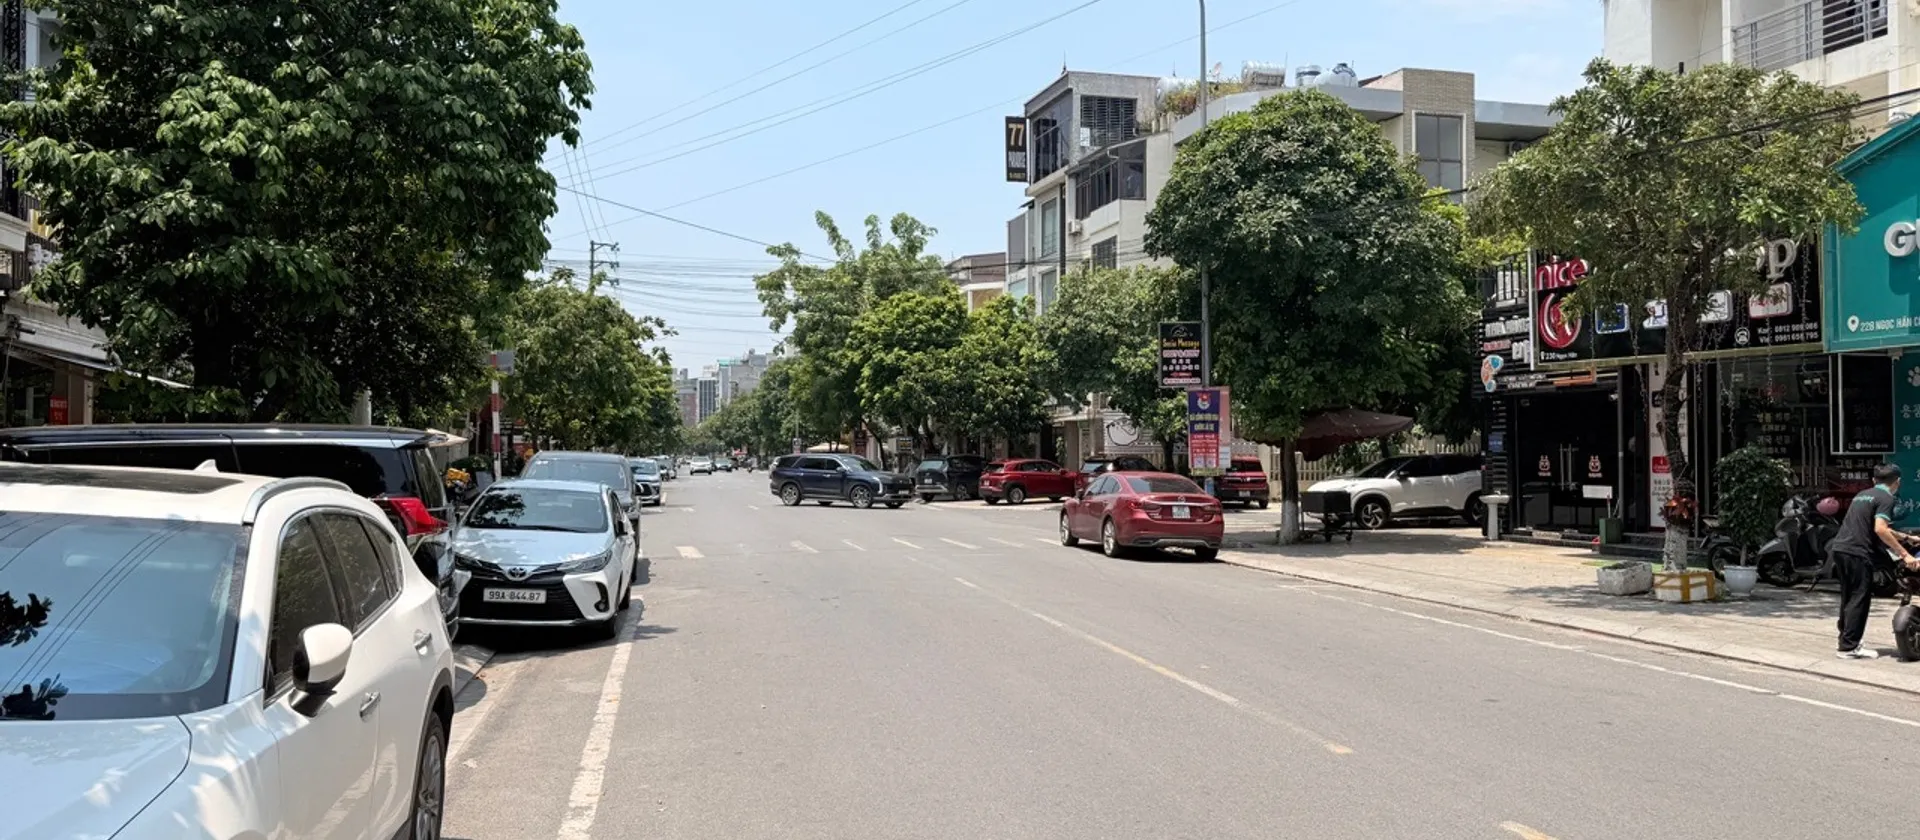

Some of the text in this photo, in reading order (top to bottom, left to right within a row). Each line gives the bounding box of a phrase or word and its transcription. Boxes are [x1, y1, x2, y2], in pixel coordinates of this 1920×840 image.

[1008, 123, 1025, 146] 77
[1535, 255, 1589, 290] nice
[1860, 321, 1875, 333] 228
[1875, 319, 1896, 332] NGỌC
